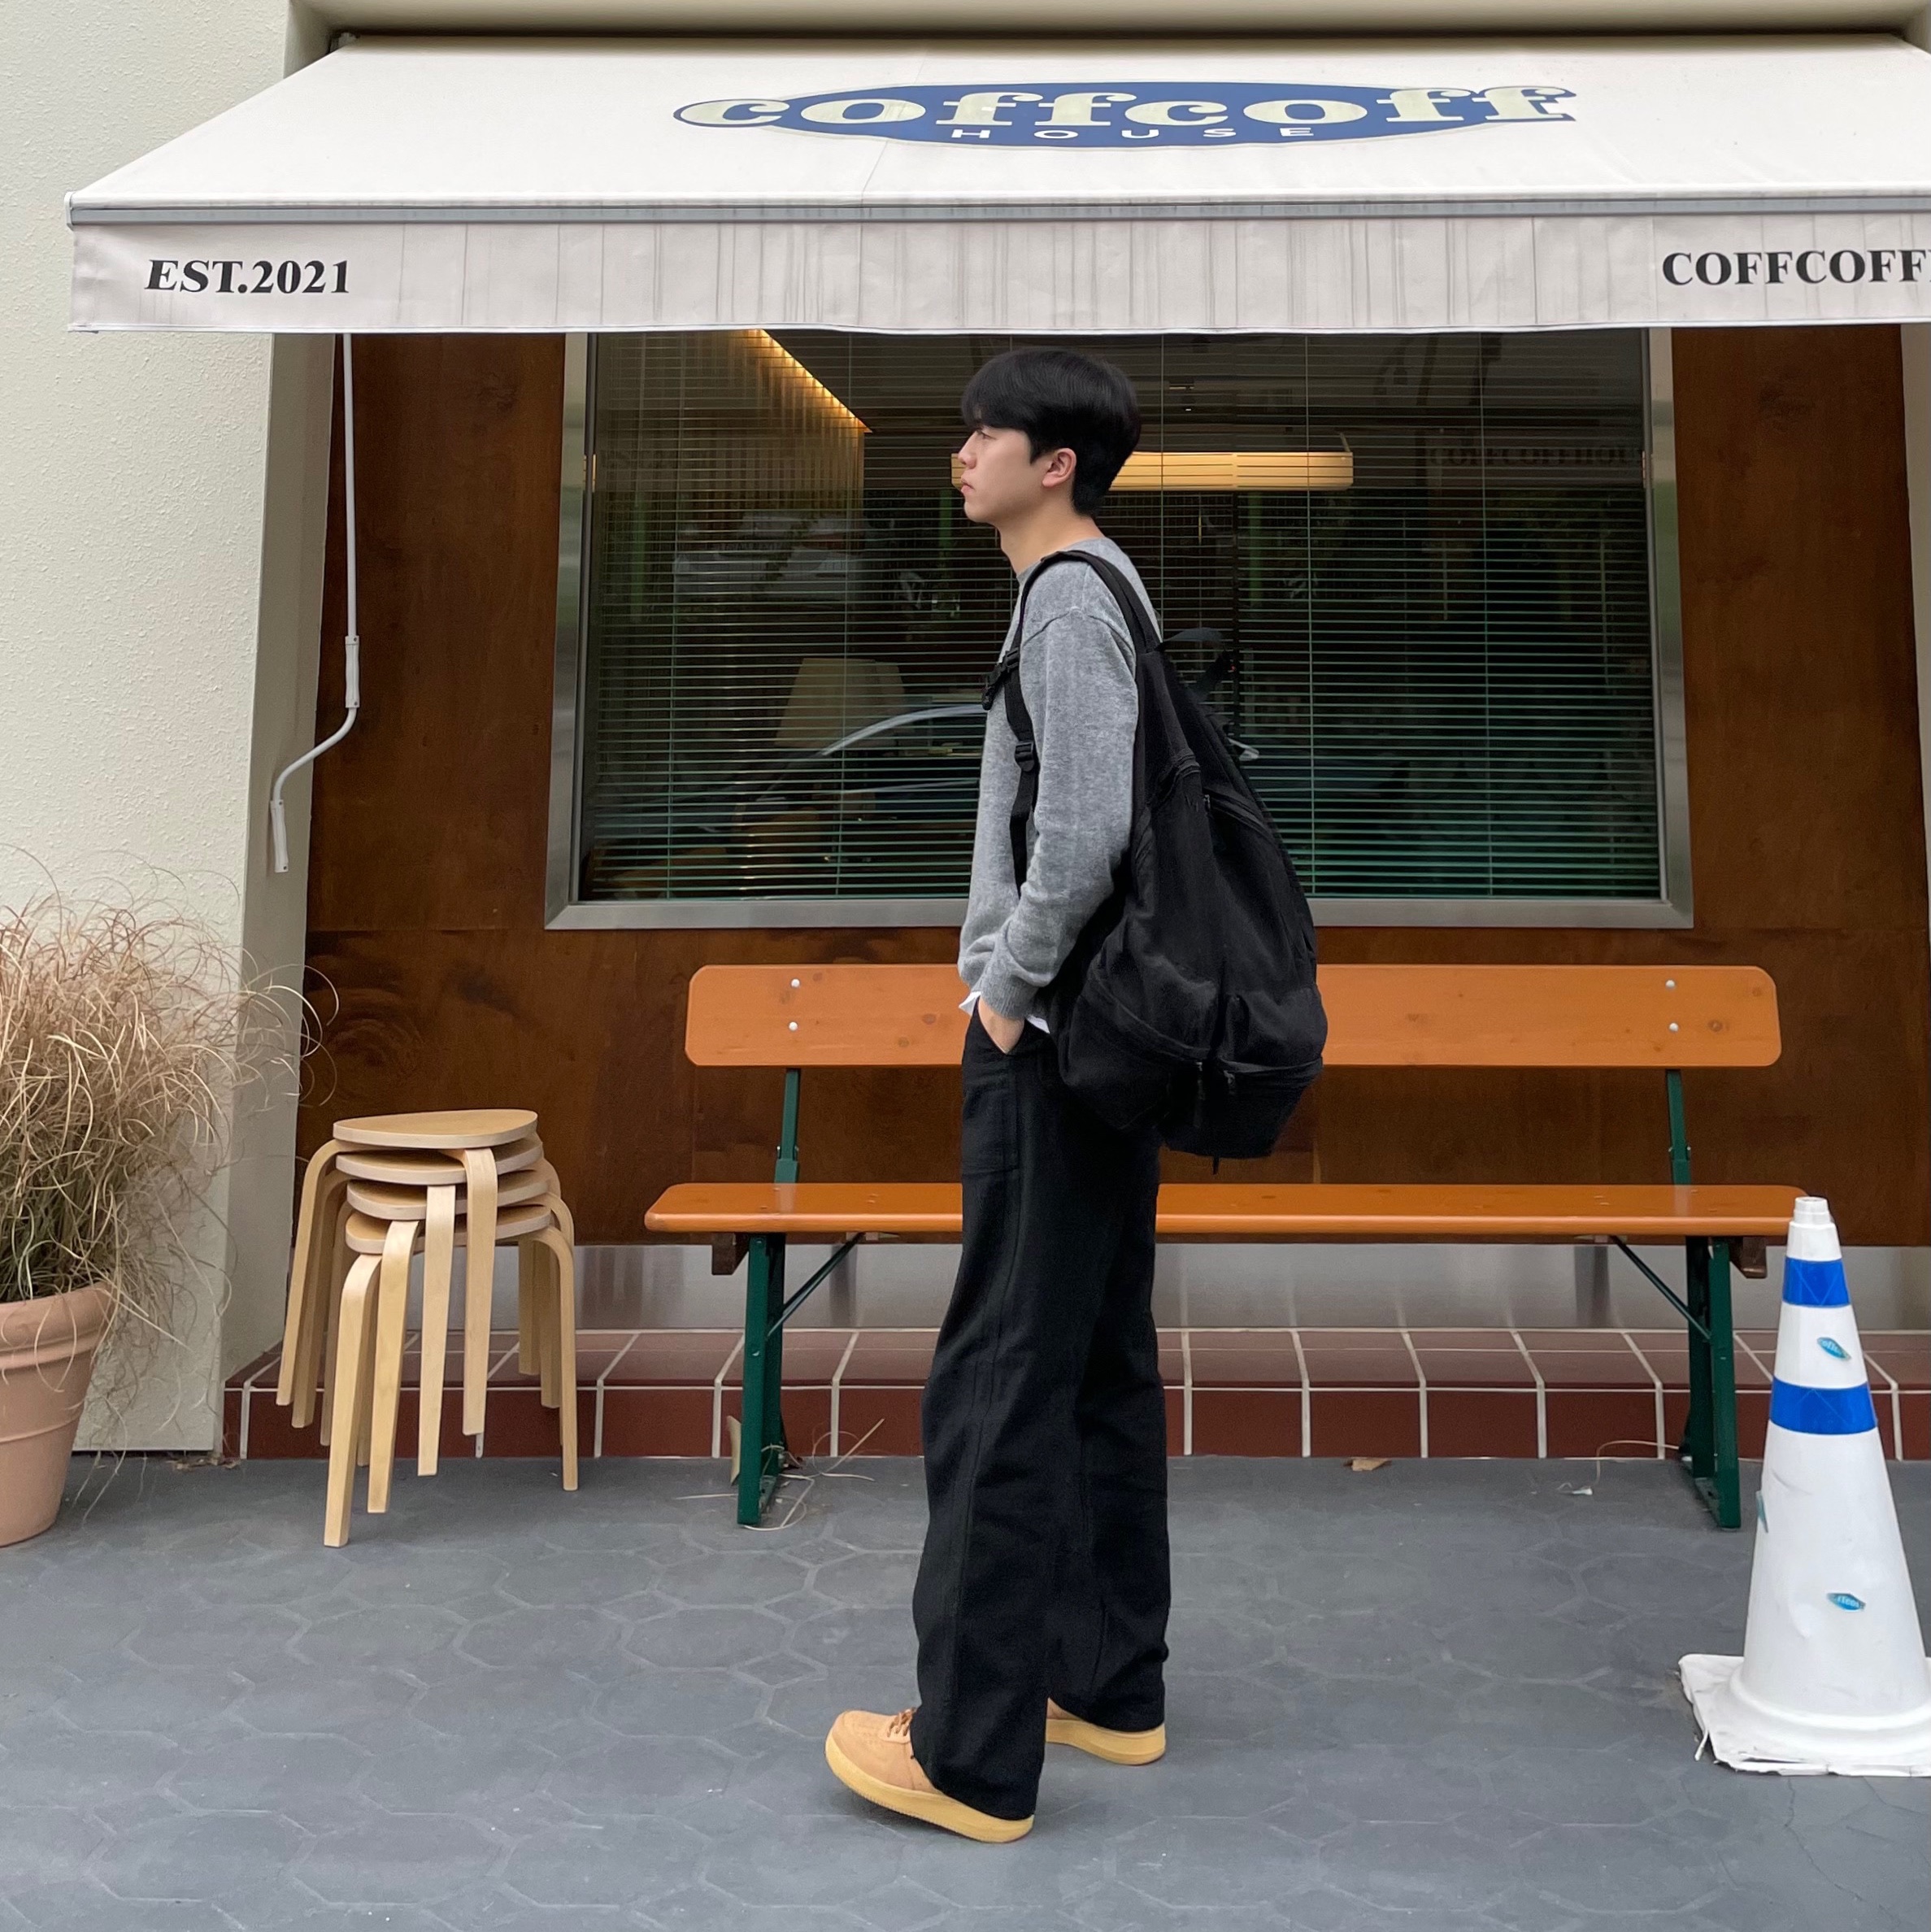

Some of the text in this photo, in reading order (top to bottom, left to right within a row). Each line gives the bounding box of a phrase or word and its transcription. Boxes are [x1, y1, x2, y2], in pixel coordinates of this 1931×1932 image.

[677, 86, 1566, 126] coffcoff
[950, 127, 1315, 139] HOUSE
[144, 259, 350, 294] EST.2021
[1662, 249, 1931, 285] COFFCOFF
